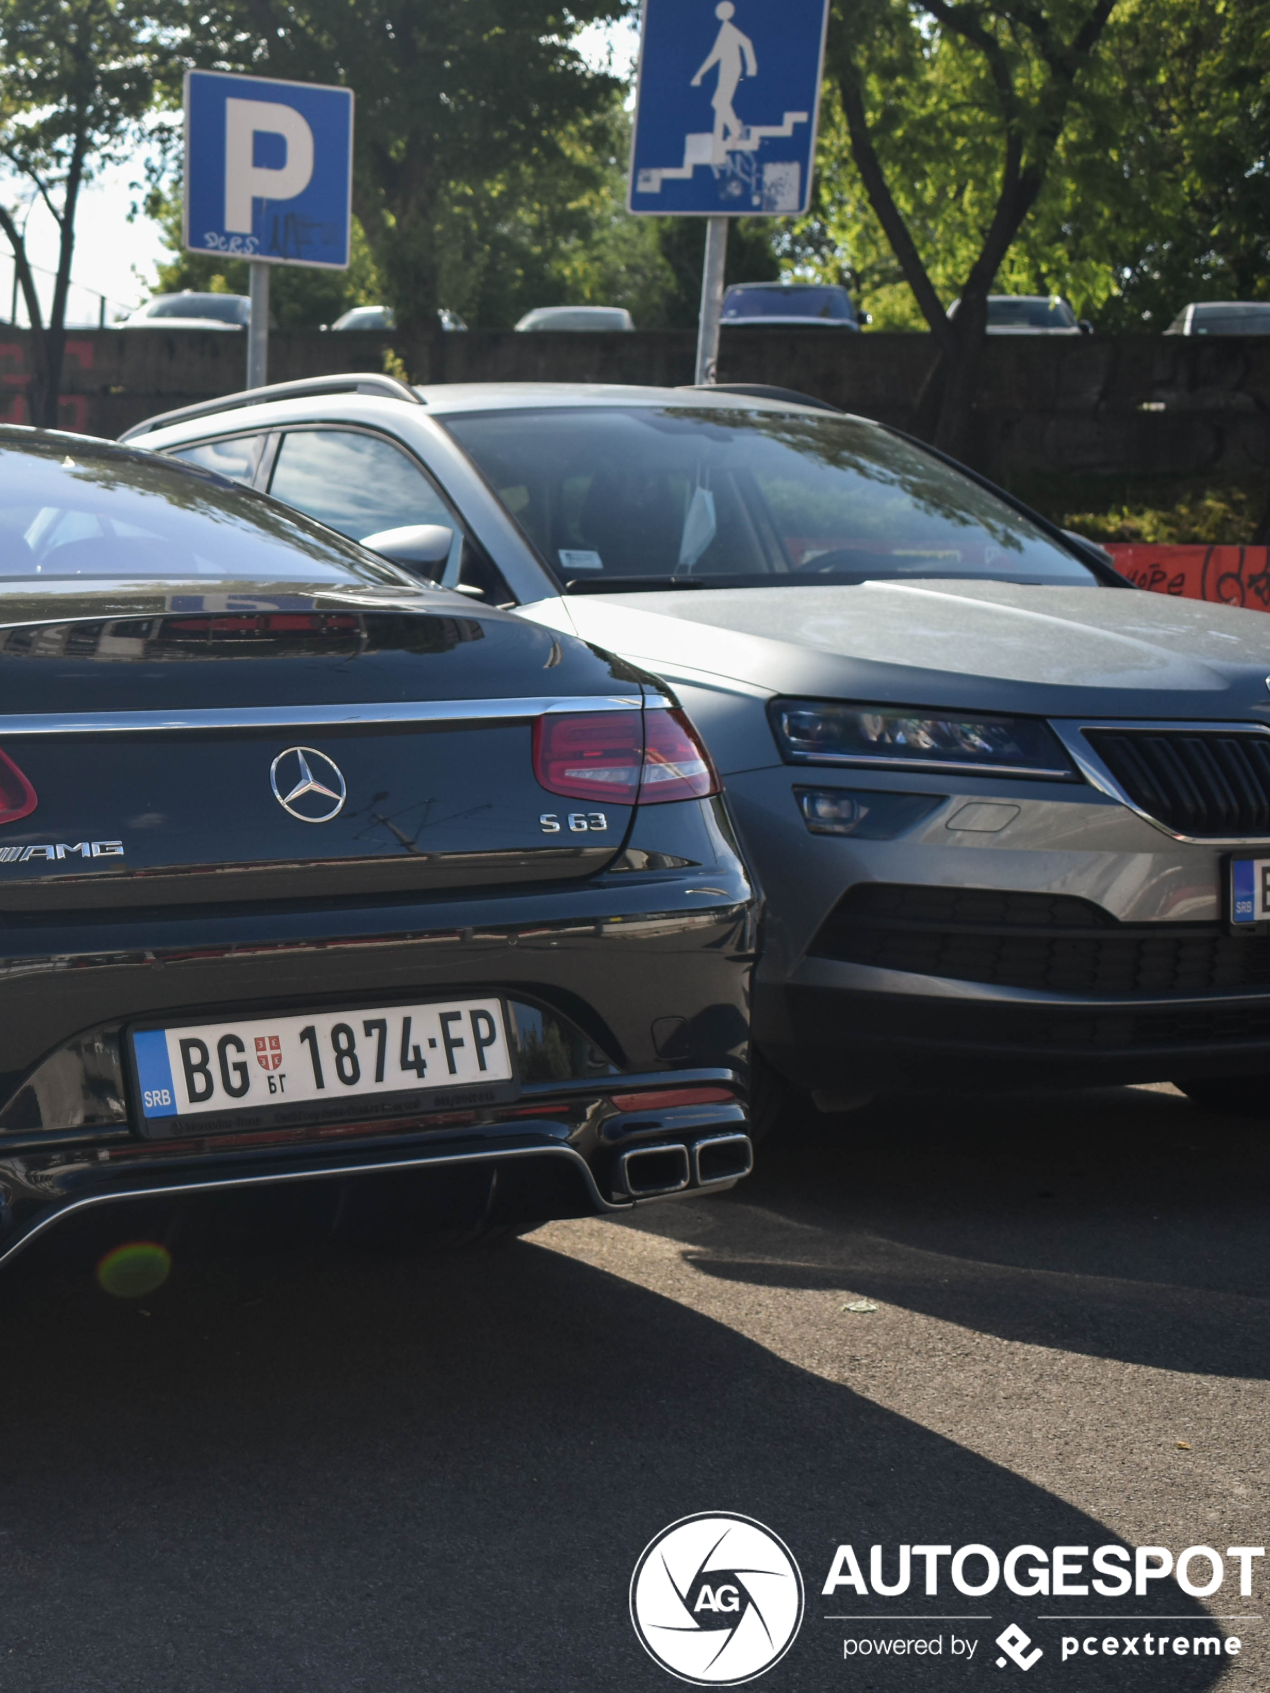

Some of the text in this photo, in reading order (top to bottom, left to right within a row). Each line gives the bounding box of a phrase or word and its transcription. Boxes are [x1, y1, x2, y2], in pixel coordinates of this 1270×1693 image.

[225, 97, 314, 234] P
[539, 812, 608, 833] S 63
[19, 840, 125, 861] AMG
[1235, 901, 1252, 914] SRB
[179, 1033, 251, 1104] BG
[143, 1089, 172, 1109] SRB
